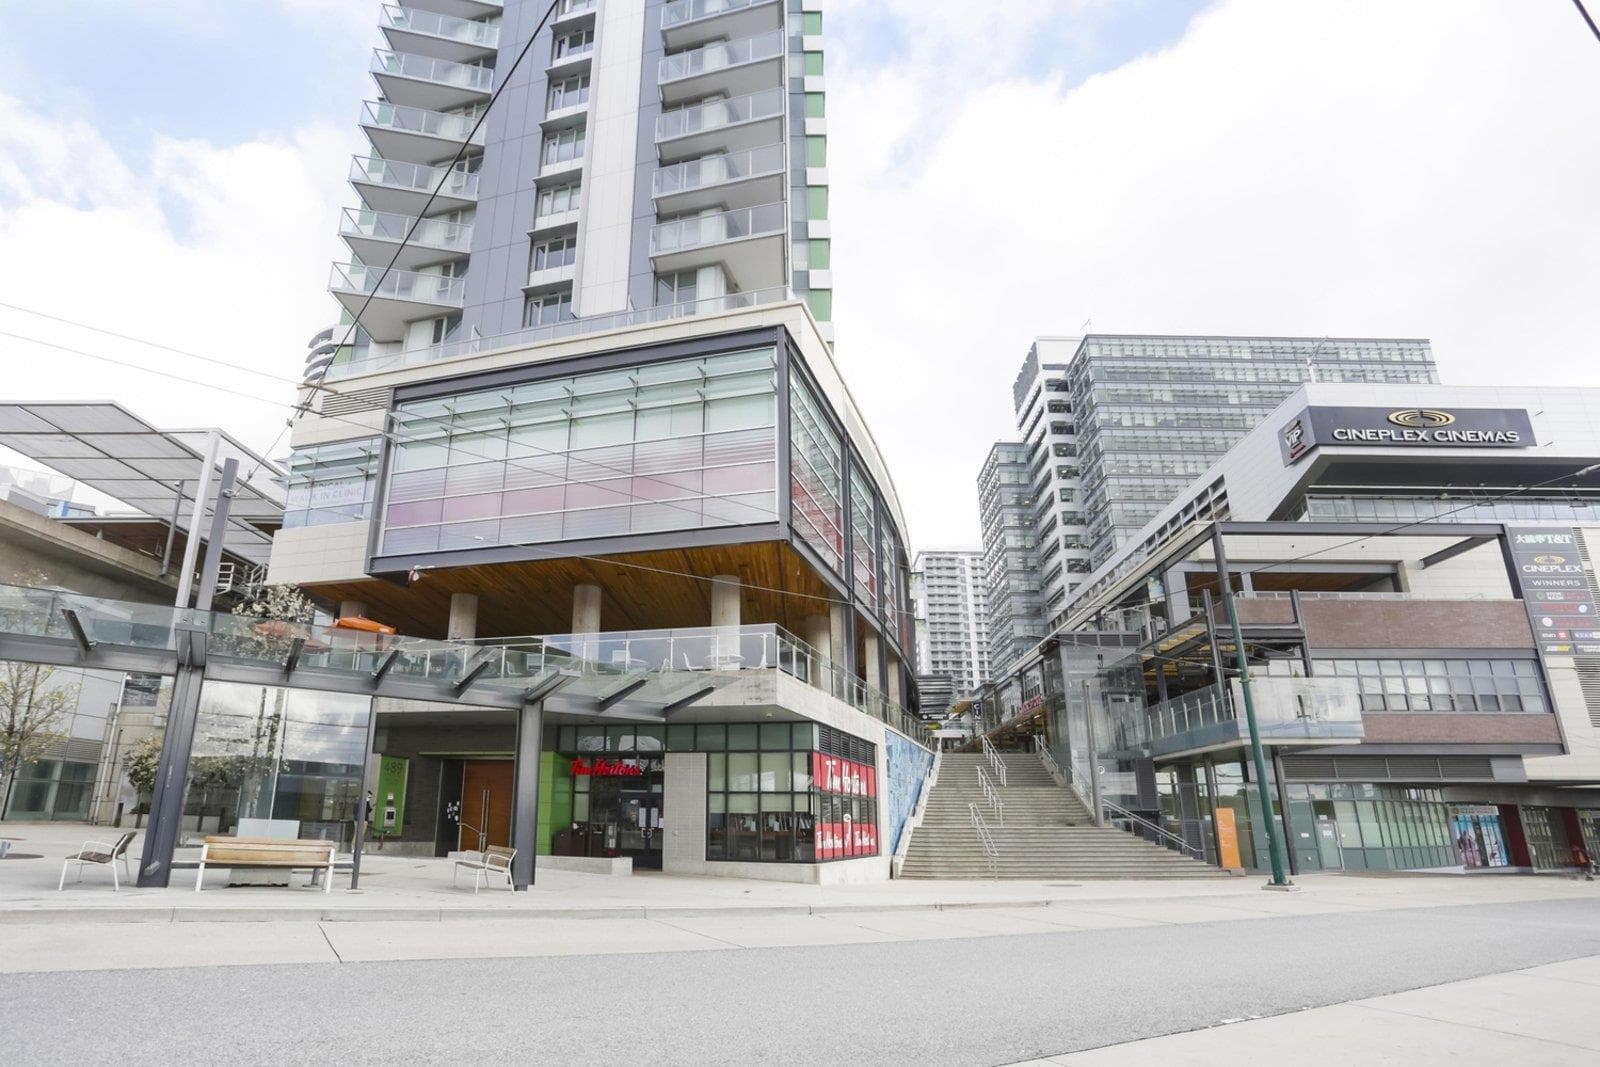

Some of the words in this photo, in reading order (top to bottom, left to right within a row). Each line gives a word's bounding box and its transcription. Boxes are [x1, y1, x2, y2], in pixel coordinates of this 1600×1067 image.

[1285, 429, 1302, 447] VIP
[1333, 428, 1429, 442] CINEPLEX
[1433, 430, 1520, 443] CINEMAS
[1522, 565, 1582, 573] CINEPLEX
[570, 758, 593, 776] Tim
[594, 758, 641, 776] Hortons
